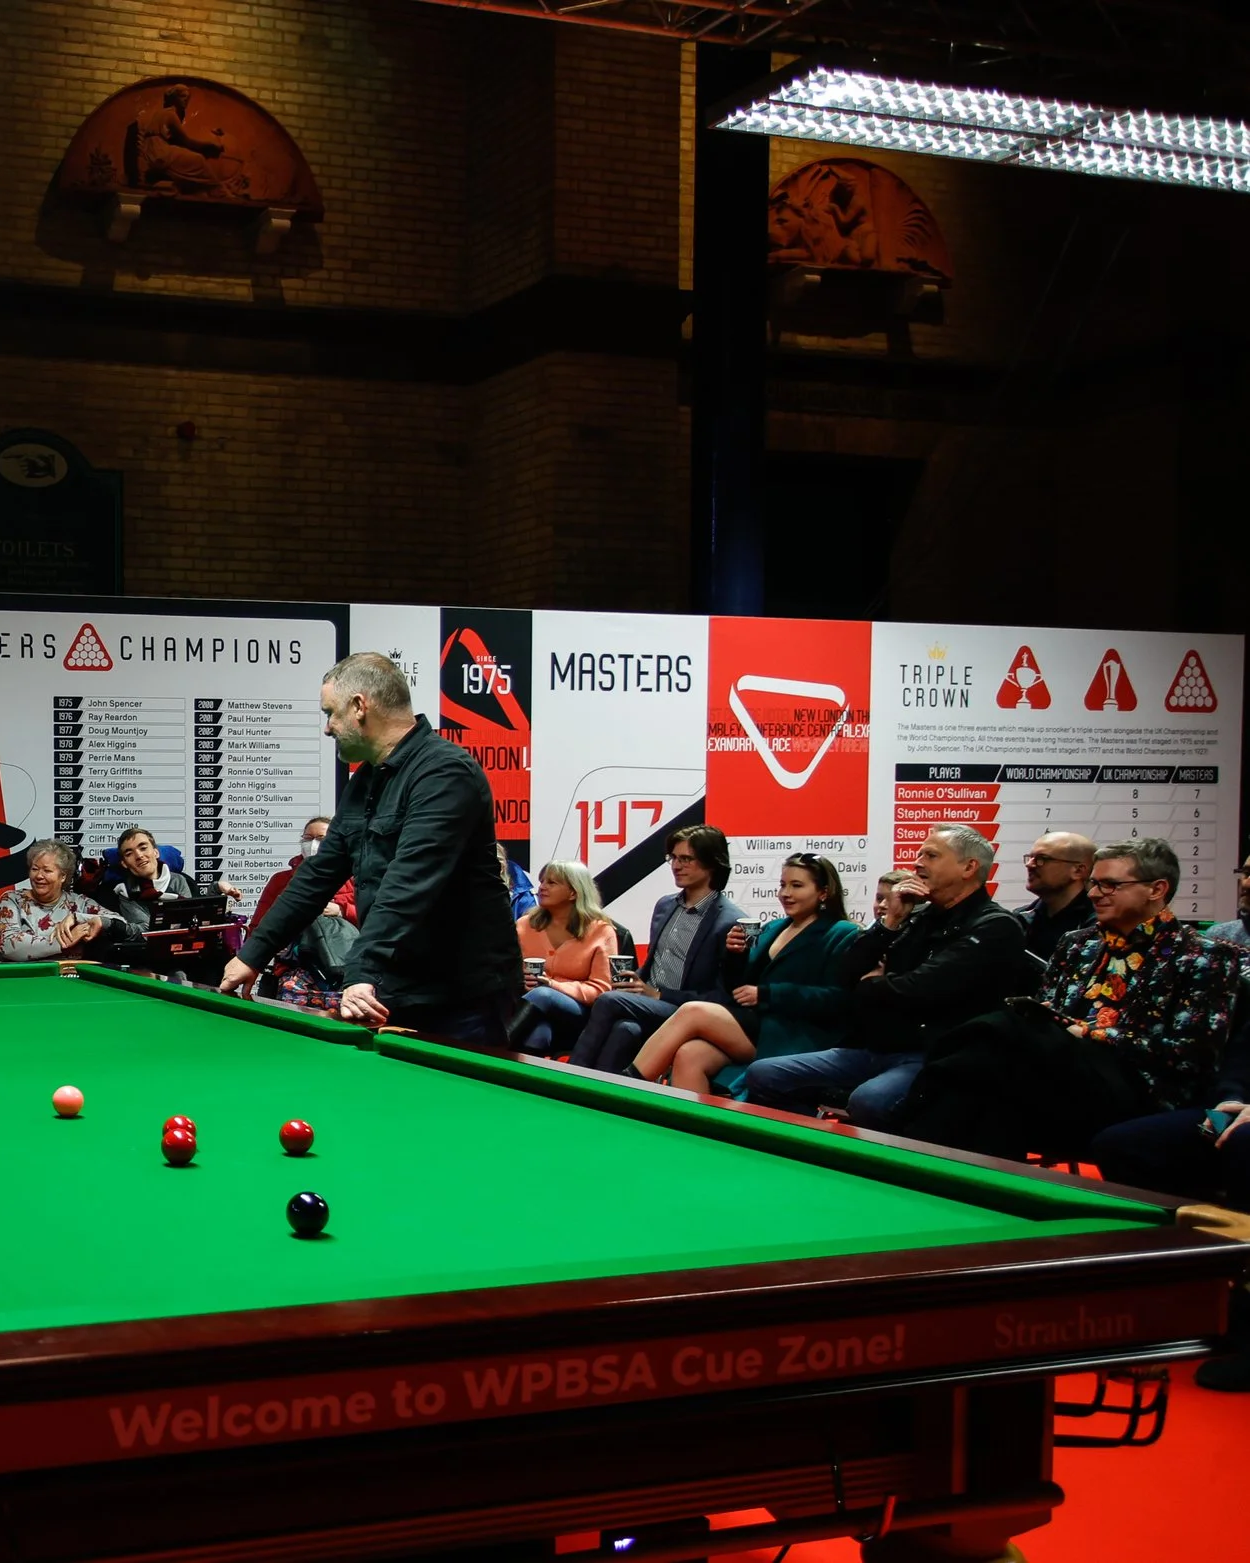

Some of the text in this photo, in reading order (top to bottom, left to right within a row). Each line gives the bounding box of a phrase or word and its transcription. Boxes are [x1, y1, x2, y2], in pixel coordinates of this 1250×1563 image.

[120, 635, 301, 664] CHAMPIONS
[476, 655, 497, 663] SINCE
[550, 652, 692, 693] MASTERS
[899, 664, 973, 686] TRIPLE
[461, 663, 511, 695] 1975
[902, 687, 969, 708] CROWN
[58, 698, 143, 710] 1975 John Spencer
[227, 701, 261, 710] Matthew
[262, 701, 293, 710] Stevens
[58, 712, 138, 723] 1976 Ray Reardon
[227, 715, 244, 723] Paul
[245, 715, 272, 723] Hunter
[794, 709, 816, 722] NEW
[817, 709, 855, 723] LONDON
[58, 725, 148, 737] 1977 Doug Mountjoy
[227, 728, 244, 736] Paul
[245, 728, 272, 736] Hunter
[742, 723, 804, 737] NFERENCE
[910, 723, 937, 731] Masters
[58, 739, 137, 750] 1978 Alex Higgins
[249, 742, 281, 750] Williams
[706, 737, 752, 752] EXANDRA
[59, 753, 136, 762] 1979 Perrie Mans
[227, 755, 244, 763] Paul
[245, 755, 272, 763] Hunter
[463, 746, 520, 771] NDON
[88, 768, 108, 777] Terry
[109, 767, 143, 776] Griffiths
[227, 768, 254, 776] Ronnie
[255, 768, 293, 776] O'Sullivan
[928, 767, 1214, 782] PLAYER WORLD CHAMPIONSHIP UK CHAMPIONSHIP MASTERS
[88, 781, 106, 789] Alex
[107, 781, 137, 791] Higgins
[227, 781, 246, 789] John
[247, 781, 276, 791] Higgins
[255, 794, 293, 802] O'Sullivan
[897, 787, 1200, 799] Ronnie O'Sullivan 7 8 7
[59, 794, 135, 803] 1982 Steve Davis
[59, 807, 143, 817] 1983 Cliff Thorburn
[248, 808, 270, 817] Selby
[897, 807, 1200, 821] Stephen Hendry 7 5 6
[59, 821, 139, 831] 1984 Jimmy White
[255, 821, 293, 829] O'Sullivan
[897, 827, 926, 839] Steve
[1131, 828, 1138, 838] 6
[1193, 827, 1200, 837] 3
[88, 836, 106, 844] Cliff
[227, 834, 247, 842] Mark
[248, 834, 270, 843] Selby
[746, 839, 792, 850] Williams
[806, 839, 845, 852] Hendry
[88, 849, 103, 857] Clif
[228, 848, 246, 857] Ding
[1192, 846, 1199, 856] 2
[228, 860, 243, 868] Neil
[244, 860, 283, 868] Robertson
[734, 862, 867, 875] Davis Davis
[1192, 865, 1198, 875] 3
[248, 874, 270, 883] Selby
[752, 887, 778, 899] Hunt
[1192, 884, 1198, 894] 2
[228, 900, 252, 908] Shaun
[1191, 903, 1198, 913] 2
[850, 909, 867, 922] dry
[993, 1304, 1136, 1349] Strachan
[108, 1324, 906, 1449] Welcome to WPBSA Cue Zone!
